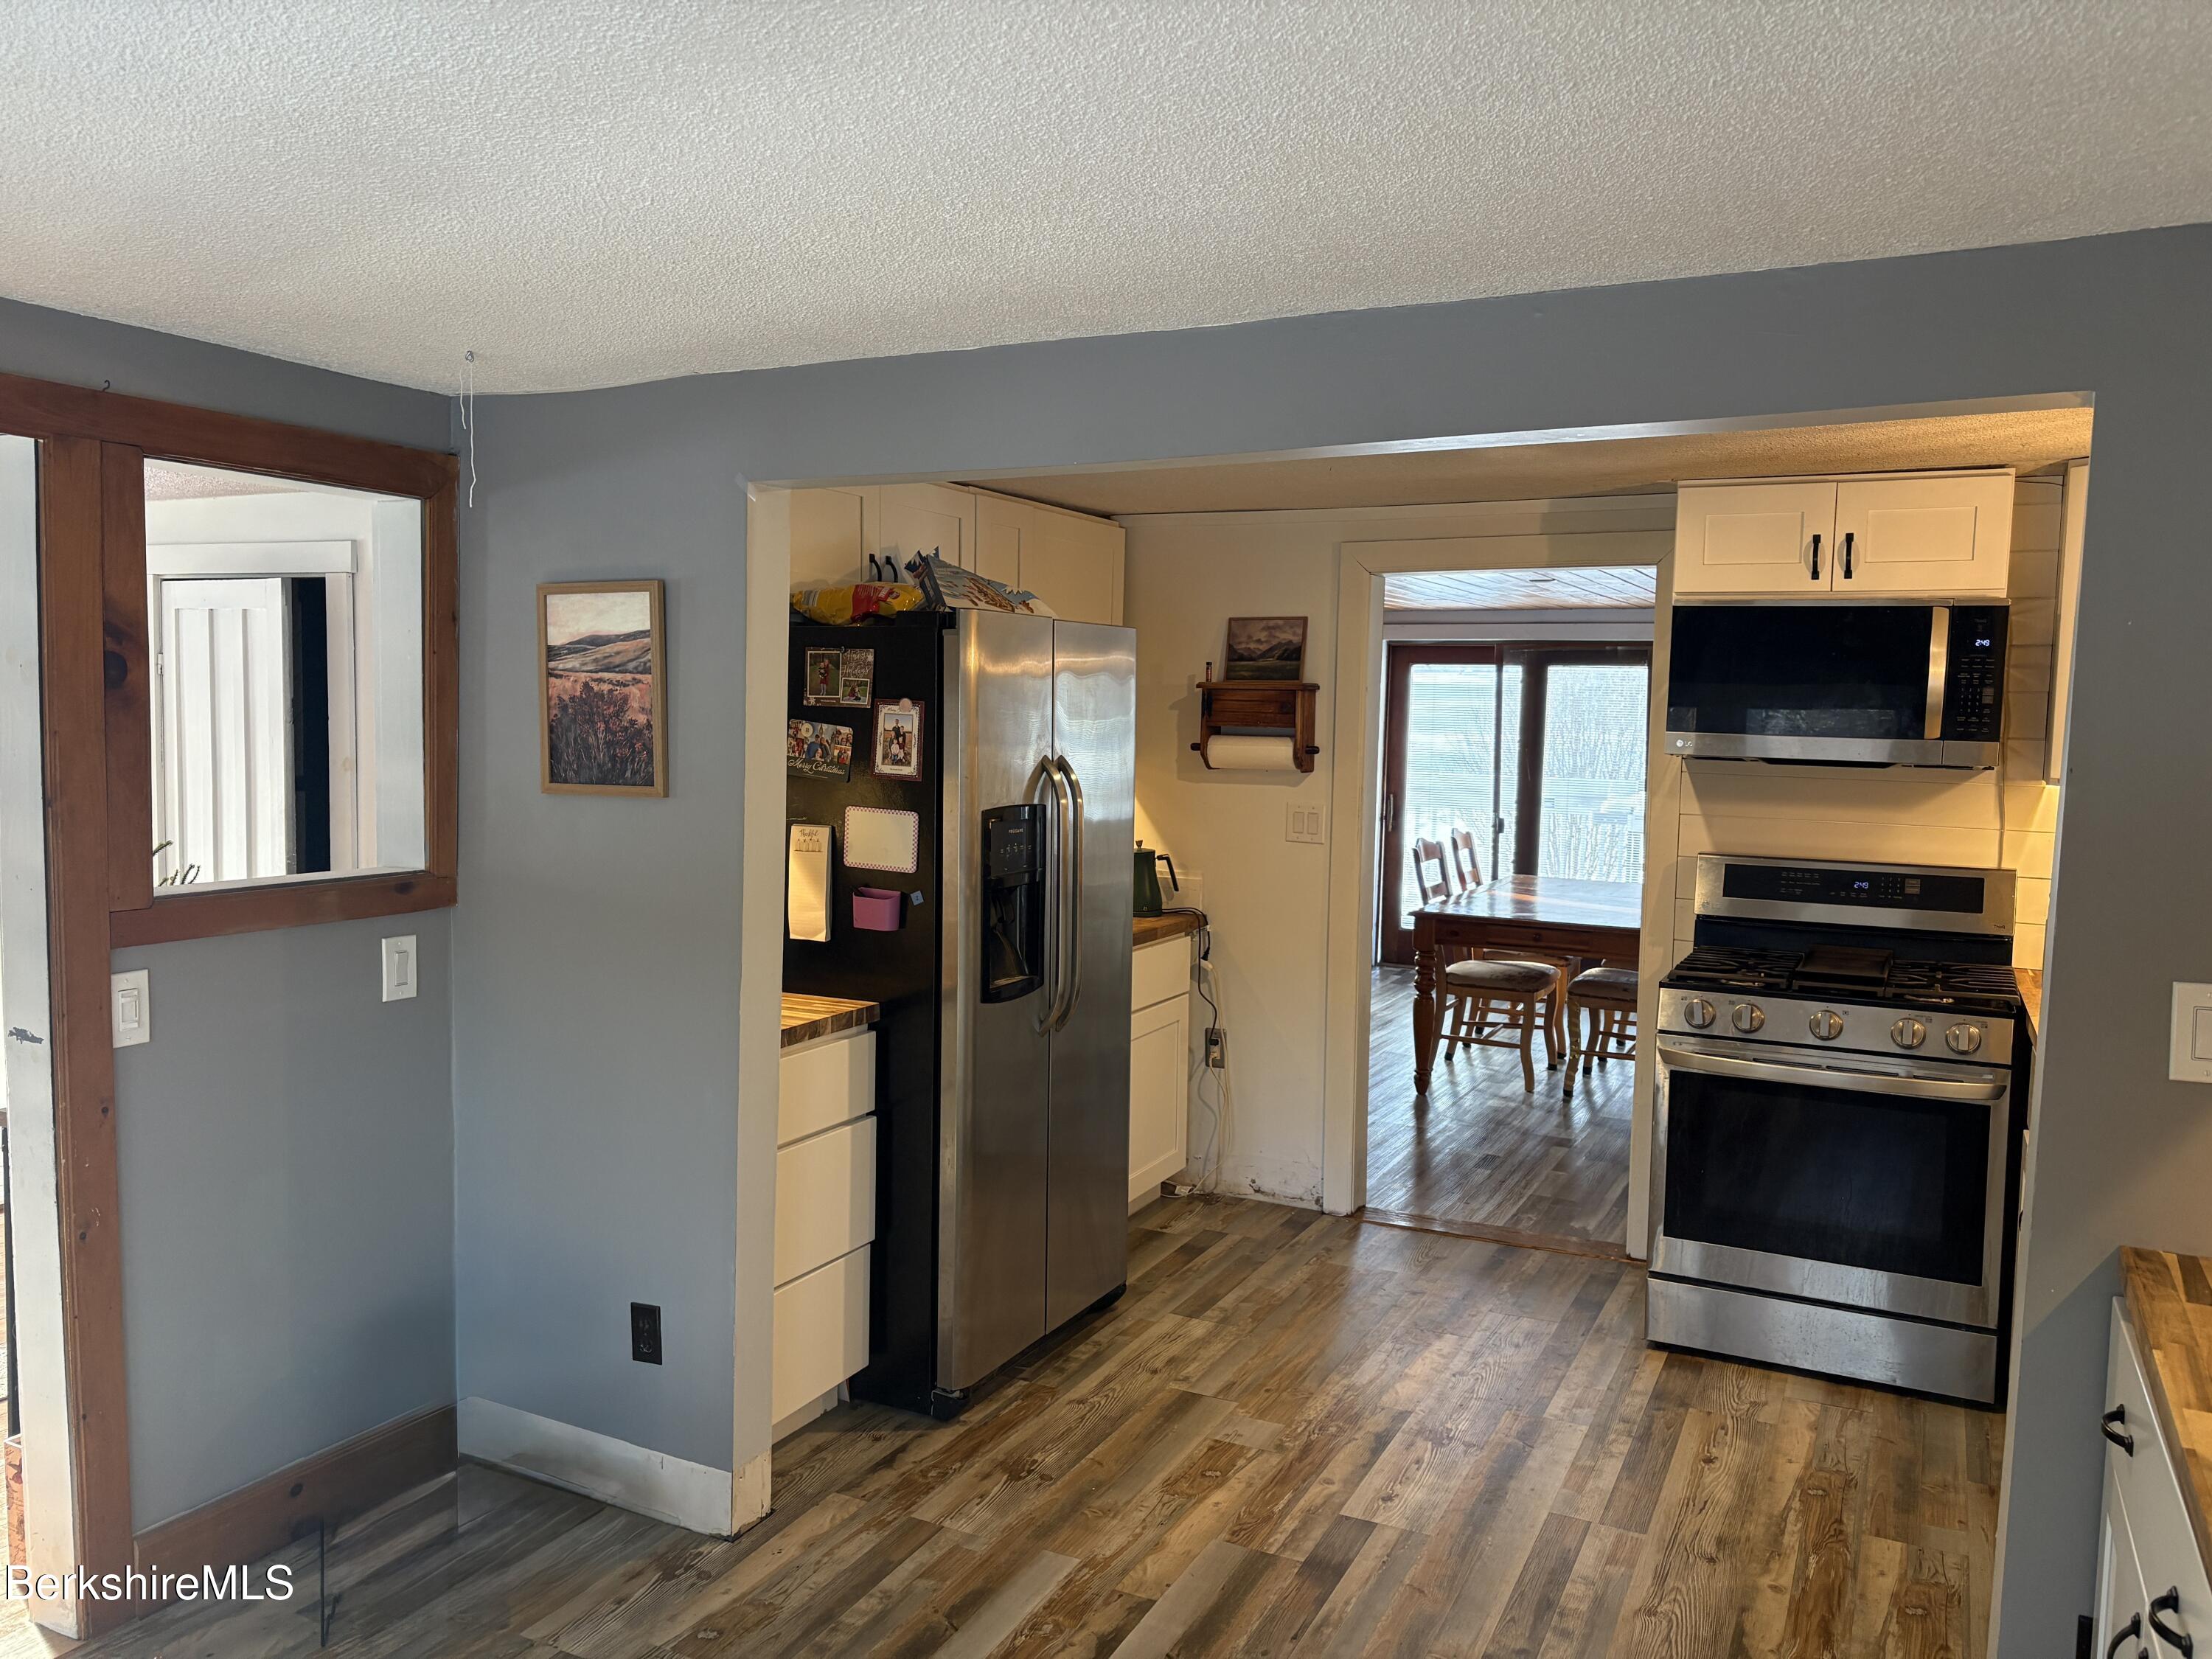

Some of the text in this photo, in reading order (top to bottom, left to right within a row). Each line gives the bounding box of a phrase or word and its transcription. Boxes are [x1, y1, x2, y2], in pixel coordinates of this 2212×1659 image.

[787, 758, 846, 775] Merry Christmas
[1854, 881, 1869, 889] 2:49
